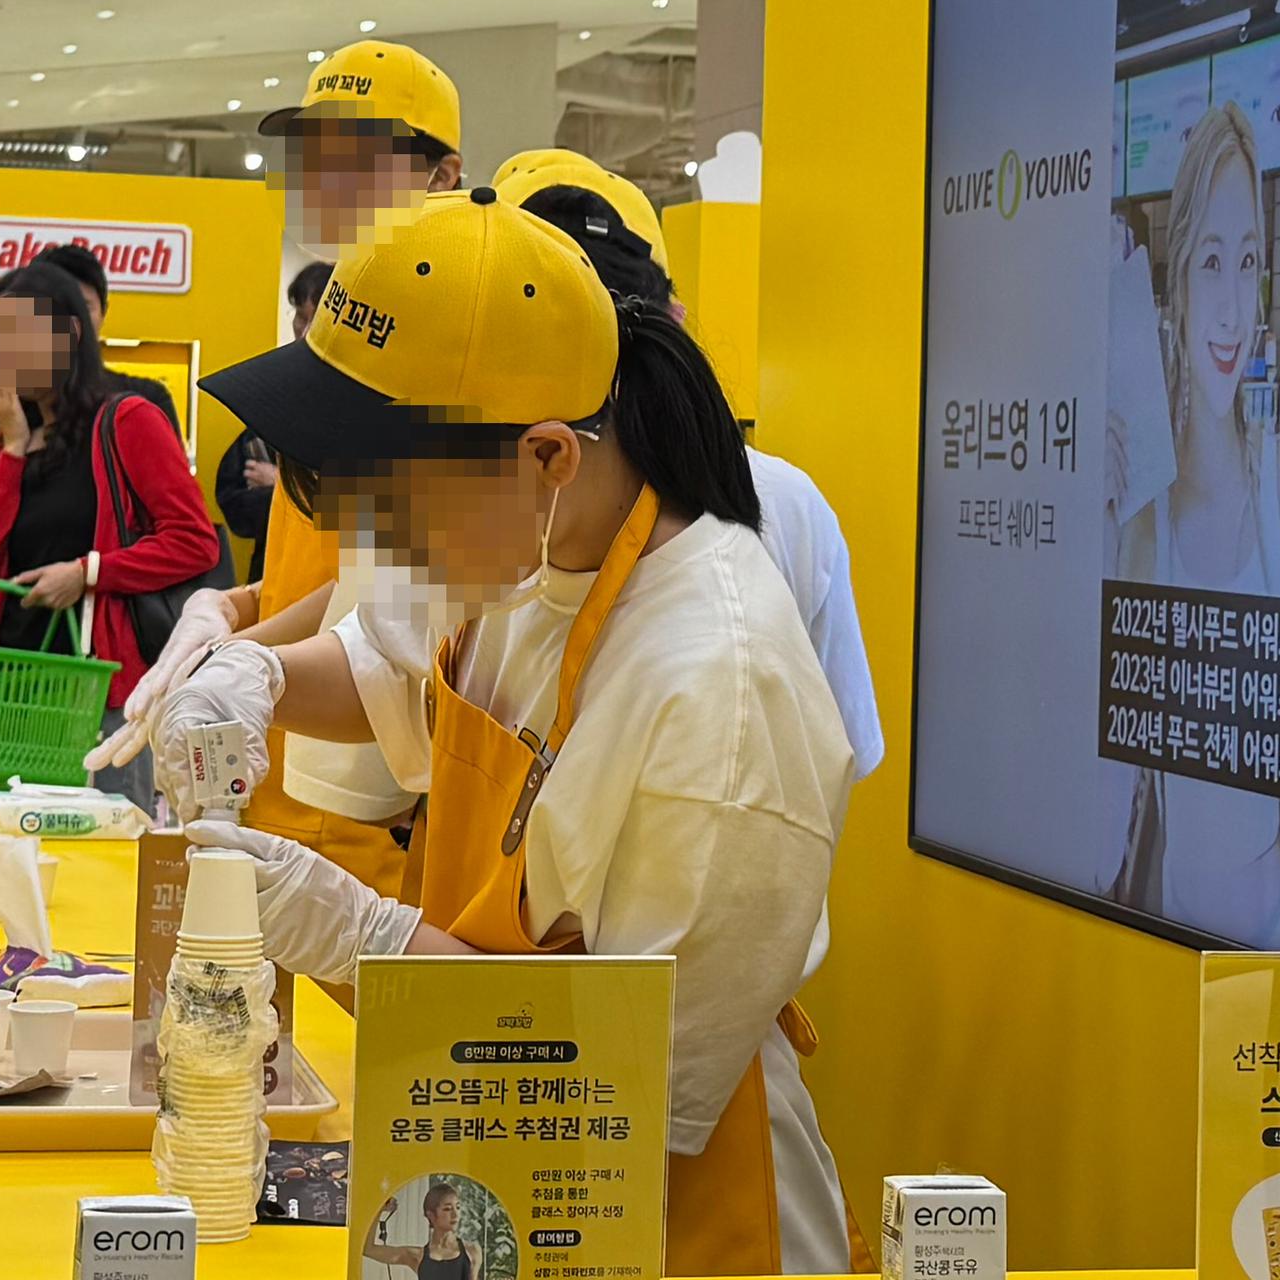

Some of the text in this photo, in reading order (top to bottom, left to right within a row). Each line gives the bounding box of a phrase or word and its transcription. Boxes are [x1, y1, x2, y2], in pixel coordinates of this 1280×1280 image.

[944, 149, 1093, 215] OLIVE YOUNG
[942, 397, 1077, 473] 올리브영 1위
[958, 499, 1056, 550] 프로틴 쉐이크
[1111, 597, 1167, 645] 2022년
[1171, 601, 1239, 653] 헬시푸드
[1110, 650, 1166, 700] 2023년
[1170, 659, 1237, 714] 이너뷰티
[1107, 705, 1163, 757] 2024년
[1167, 715, 1200, 760] 푸드
[1204, 722, 1238, 774] 전체
[464, 1045, 564, 1060] 6만원 이상 구매 시
[408, 1077, 616, 1106] 심으뜸과 함께하는
[390, 1116, 631, 1143] 운동 클래스 추첨권 제공
[532, 1168, 625, 1181] 6만원 이상 구매 시
[532, 1187, 588, 1200] 추첨을 통한
[532, 1205, 624, 1218] 클래스 참여자 선정
[914, 1206, 996, 1226] erom
[94, 1230, 184, 1251] erom
[913, 1259, 978, 1275] 국산콩 두유
